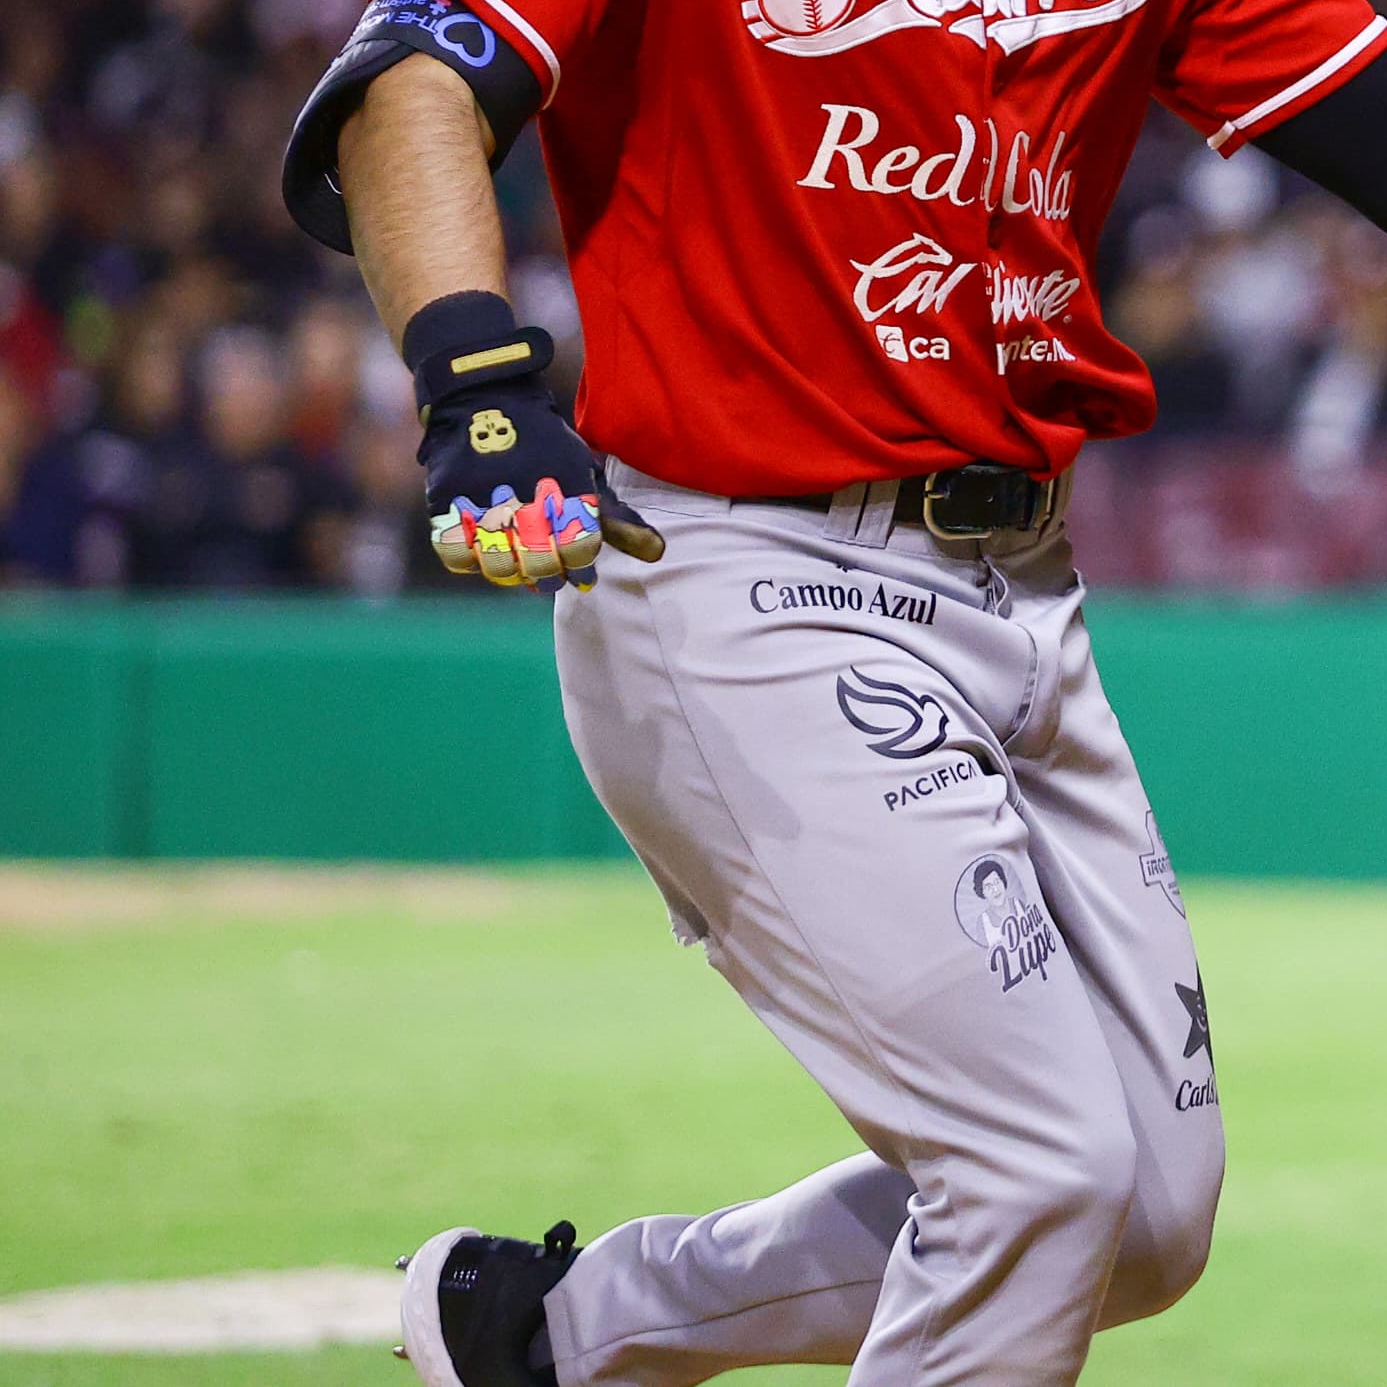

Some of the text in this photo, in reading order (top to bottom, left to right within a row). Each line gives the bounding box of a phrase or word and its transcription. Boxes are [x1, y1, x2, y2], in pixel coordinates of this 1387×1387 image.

[1001, 129, 1073, 221] Cola
[749, 578, 938, 627] Campo Azul
[989, 922, 1057, 994] Lupe
